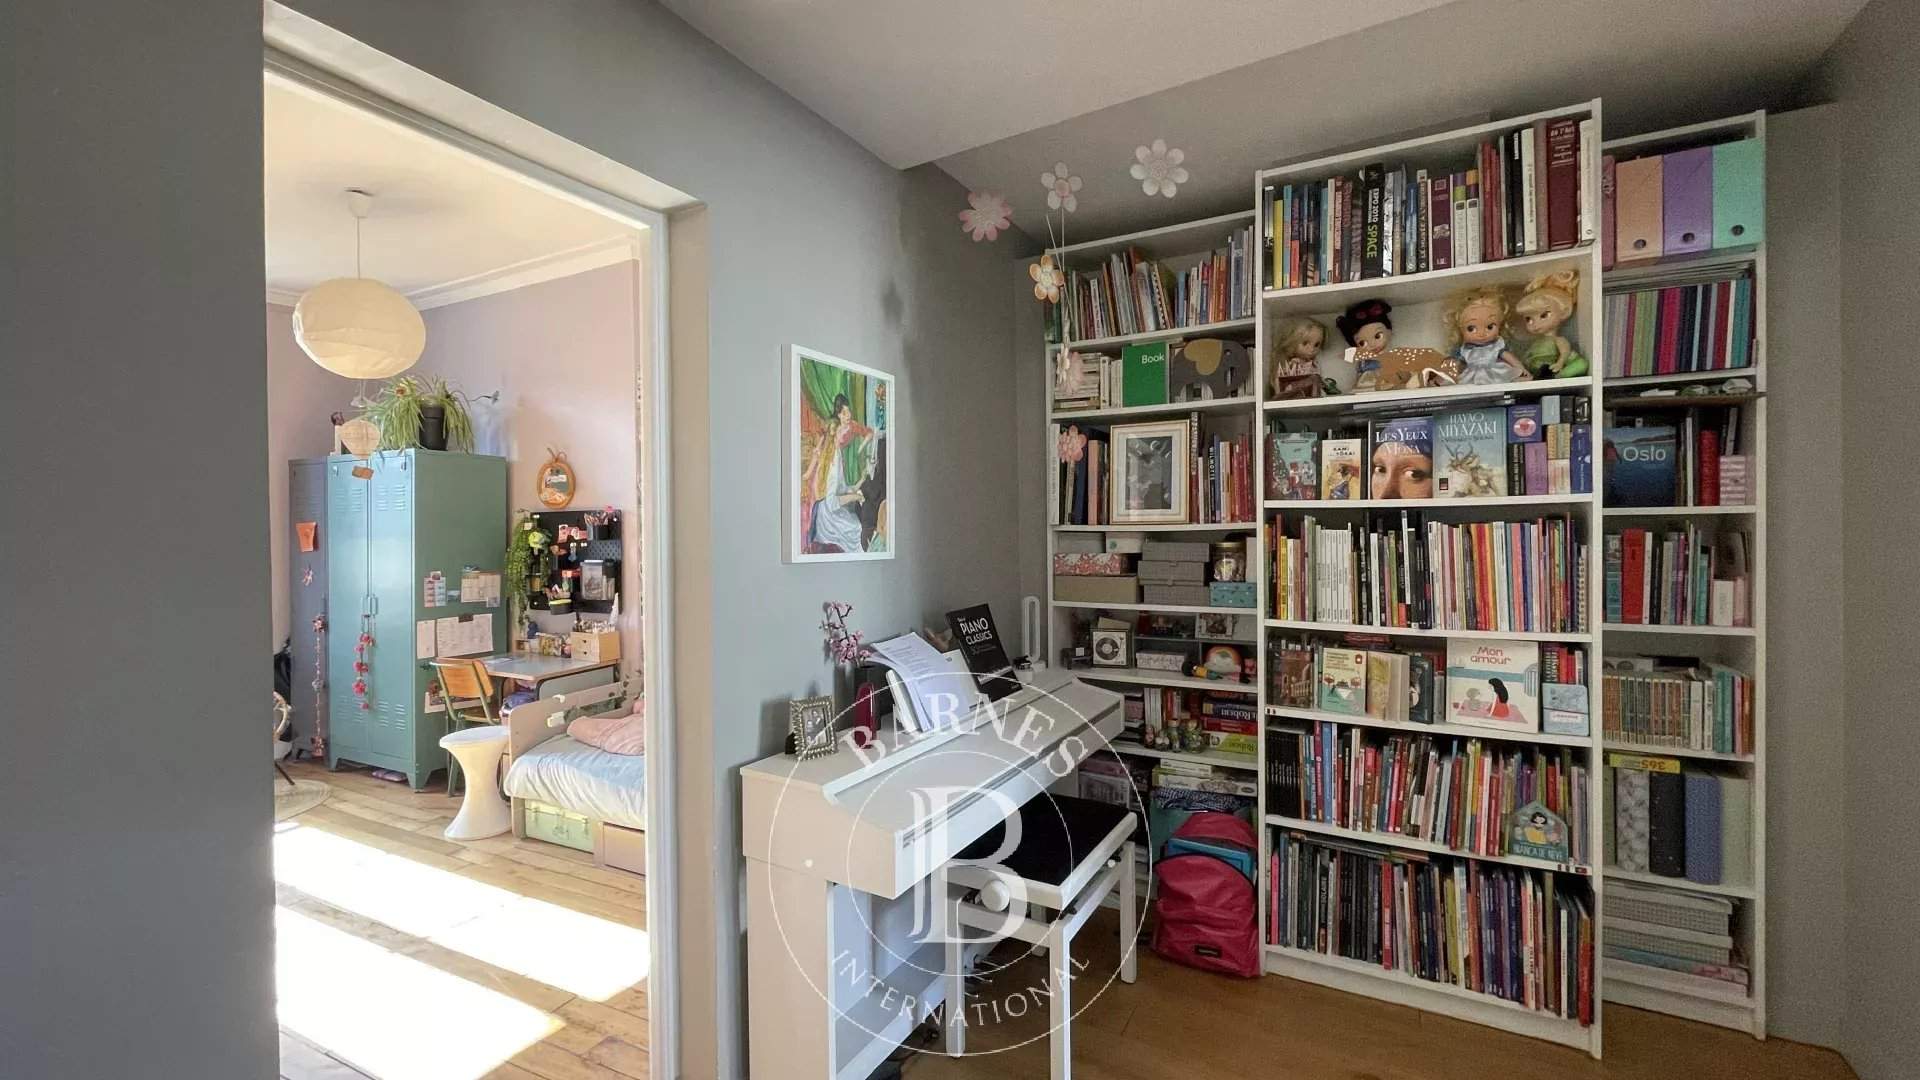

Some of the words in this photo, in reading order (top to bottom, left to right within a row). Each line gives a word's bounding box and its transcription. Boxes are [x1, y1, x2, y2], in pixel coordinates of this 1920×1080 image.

[1366, 224, 1378, 258] SPACE
[1142, 352, 1165, 364] Book
[1450, 412, 1485, 424] HAYAO
[1440, 421, 1497, 438] MIYAZAKI
[1623, 445, 1666, 461] Oslo
[959, 617, 989, 635] PIANO
[965, 630, 993, 645] CLASSICS
[1477, 646, 1503, 656] Mon
[1471, 655, 1511, 664] amour
[1641, 759, 1665, 771] 365
